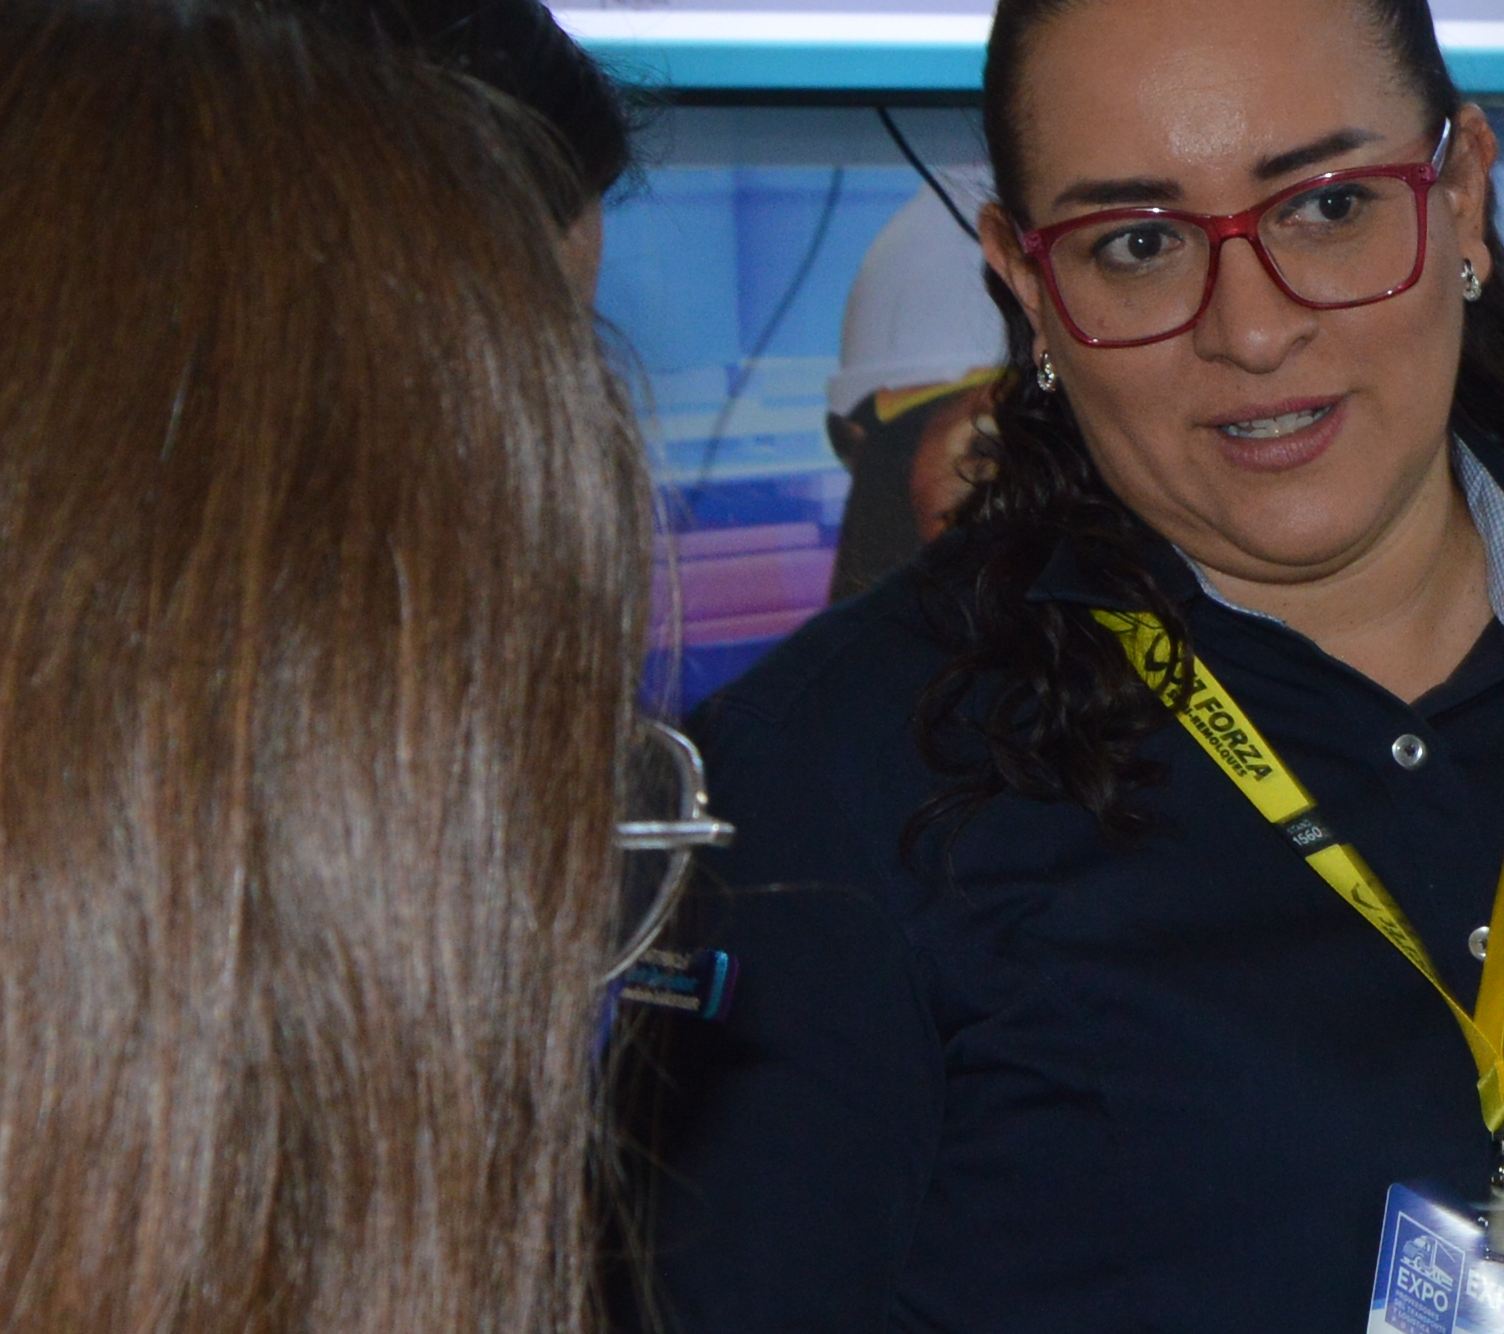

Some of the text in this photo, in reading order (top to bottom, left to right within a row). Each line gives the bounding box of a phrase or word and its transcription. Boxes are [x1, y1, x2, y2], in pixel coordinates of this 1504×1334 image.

[1196, 696, 1273, 782] FORZA
[1293, 827, 1322, 845] 1560
[1397, 1267, 1448, 1312] EXPO
